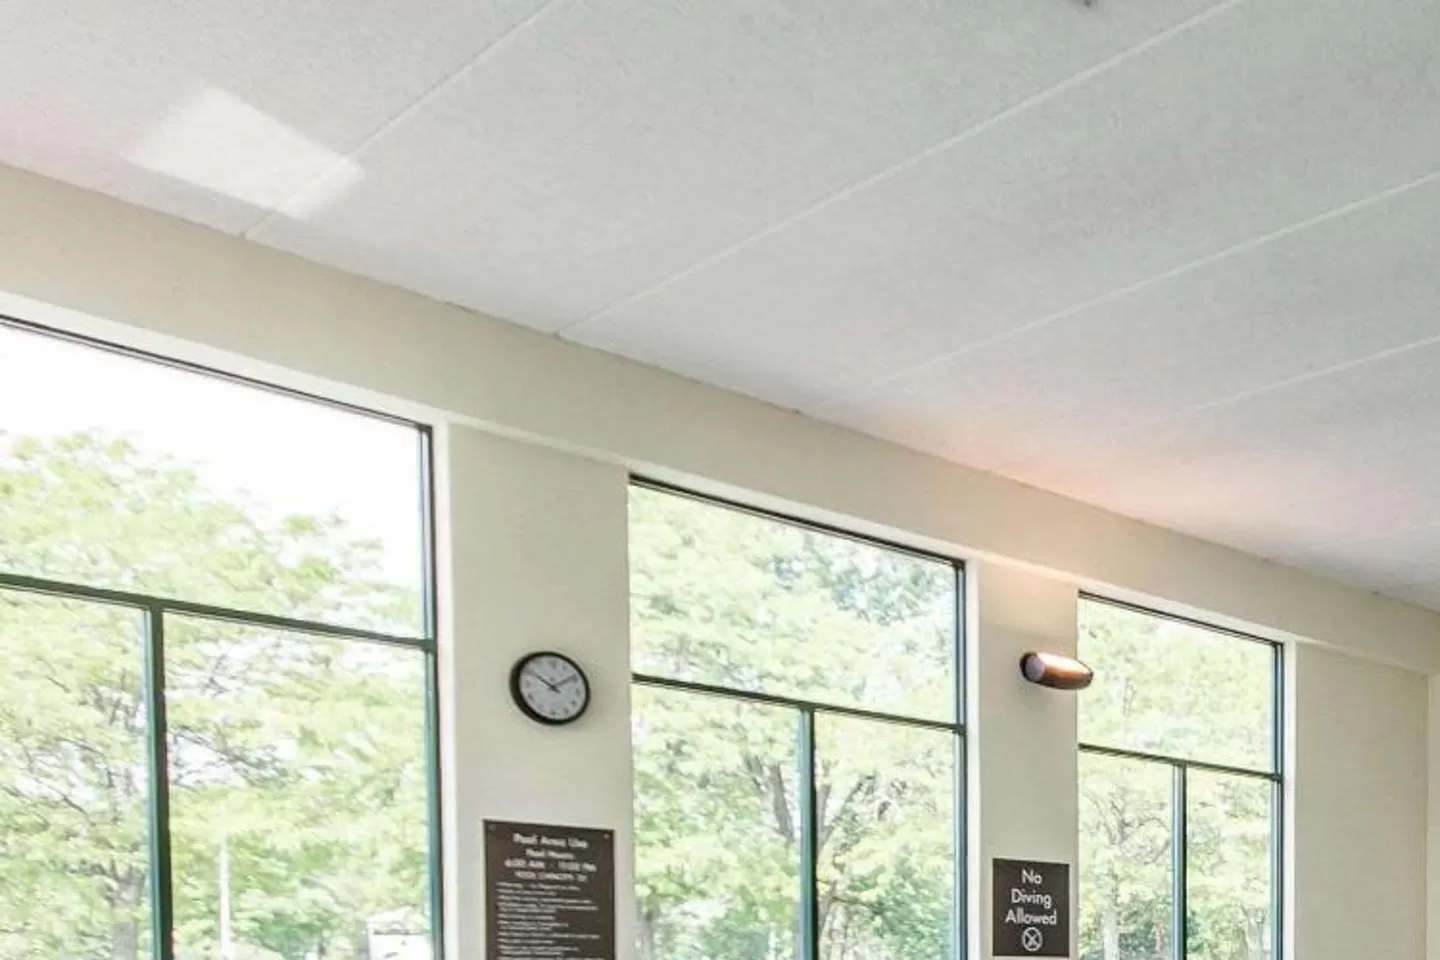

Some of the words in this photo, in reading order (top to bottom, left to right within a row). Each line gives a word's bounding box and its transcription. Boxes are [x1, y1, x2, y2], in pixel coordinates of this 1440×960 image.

[1022, 868, 1042, 885] No
[1011, 887, 1052, 909] Diving
[1005, 906, 1057, 925] Allowed
